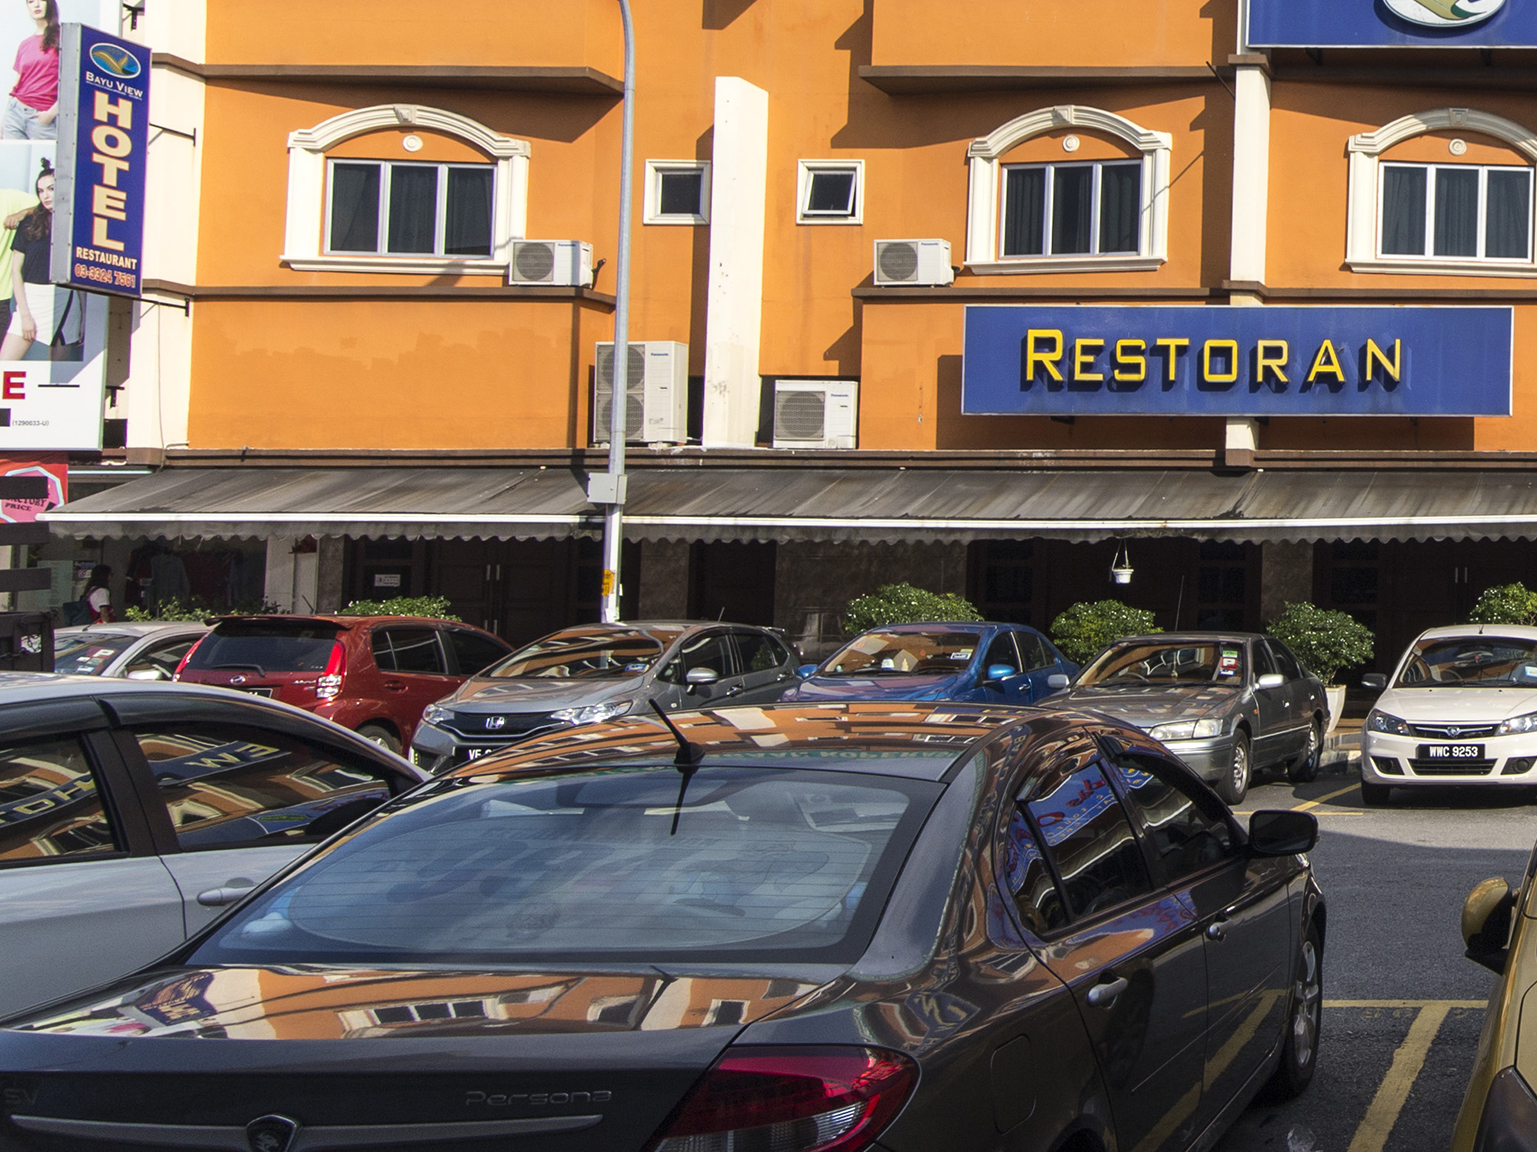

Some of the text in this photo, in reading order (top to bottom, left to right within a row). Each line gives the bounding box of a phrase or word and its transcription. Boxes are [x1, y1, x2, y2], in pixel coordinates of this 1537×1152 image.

[86, 71, 143, 97] BAYU VIEW
[91, 89, 133, 252] HOTEL
[76, 246, 137, 270] RESTAURANT
[75, 263, 112, 283] 03-3324
[1025, 328, 1403, 383] RESTORAN
[1429, 746, 1479, 758] WWC 9253
